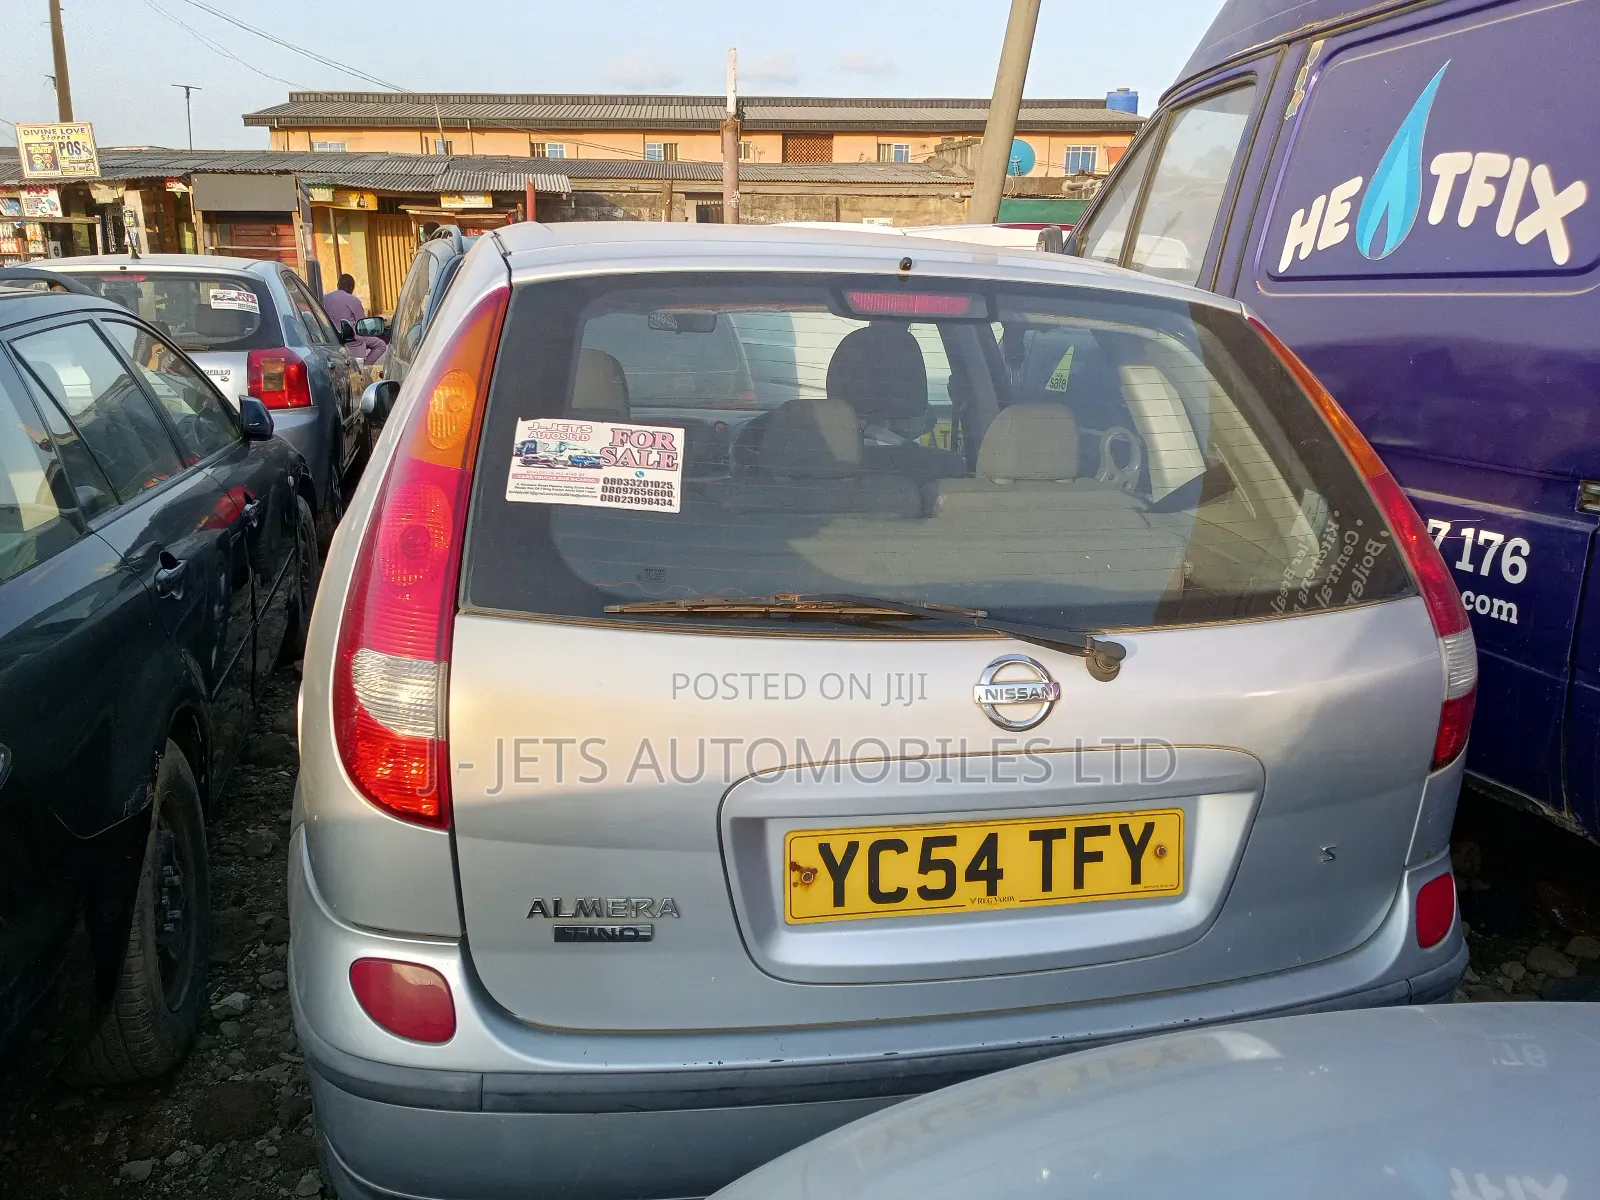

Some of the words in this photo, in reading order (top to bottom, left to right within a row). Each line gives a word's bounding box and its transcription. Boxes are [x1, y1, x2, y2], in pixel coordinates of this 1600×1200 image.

[23, 128, 58, 136] DIVINE
[60, 127, 86, 135] LOVE
[57, 140, 82, 156] POS
[27, 184, 49, 195] POS
[528, 422, 594, 433] J-JETS
[528, 431, 567, 440] AUTOS
[569, 433, 591, 442] LTD
[609, 428, 677, 451] FOR
[600, 446, 679, 472] SALE
[1455, 527, 1531, 585] 176
[984, 685, 1055, 701] NISSAN
[818, 832, 1004, 908] YC54
[1028, 821, 1155, 893] TFY
[525, 897, 681, 919] ALMERA
[564, 926, 641, 941] TINO
